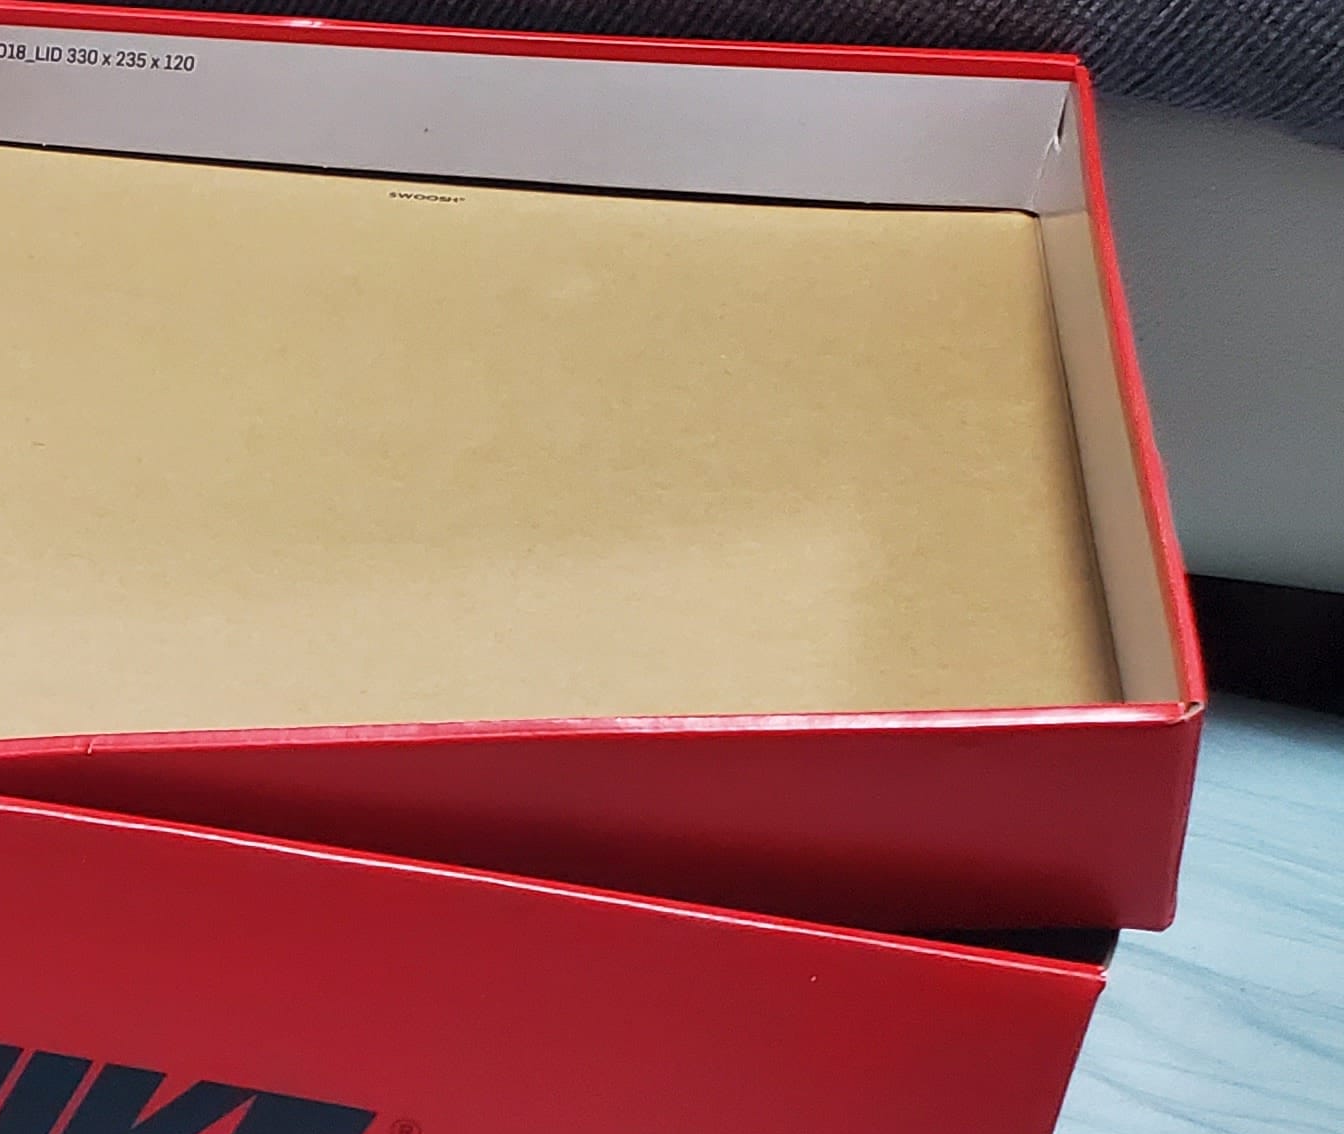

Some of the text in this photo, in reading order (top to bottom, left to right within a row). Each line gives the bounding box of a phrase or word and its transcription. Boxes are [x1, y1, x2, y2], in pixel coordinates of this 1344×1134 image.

[66, 48, 99, 65] 330
[102, 53, 112, 66] x
[115, 51, 147, 69] 235
[150, 56, 160, 69] x
[164, 54, 195, 72] 120
